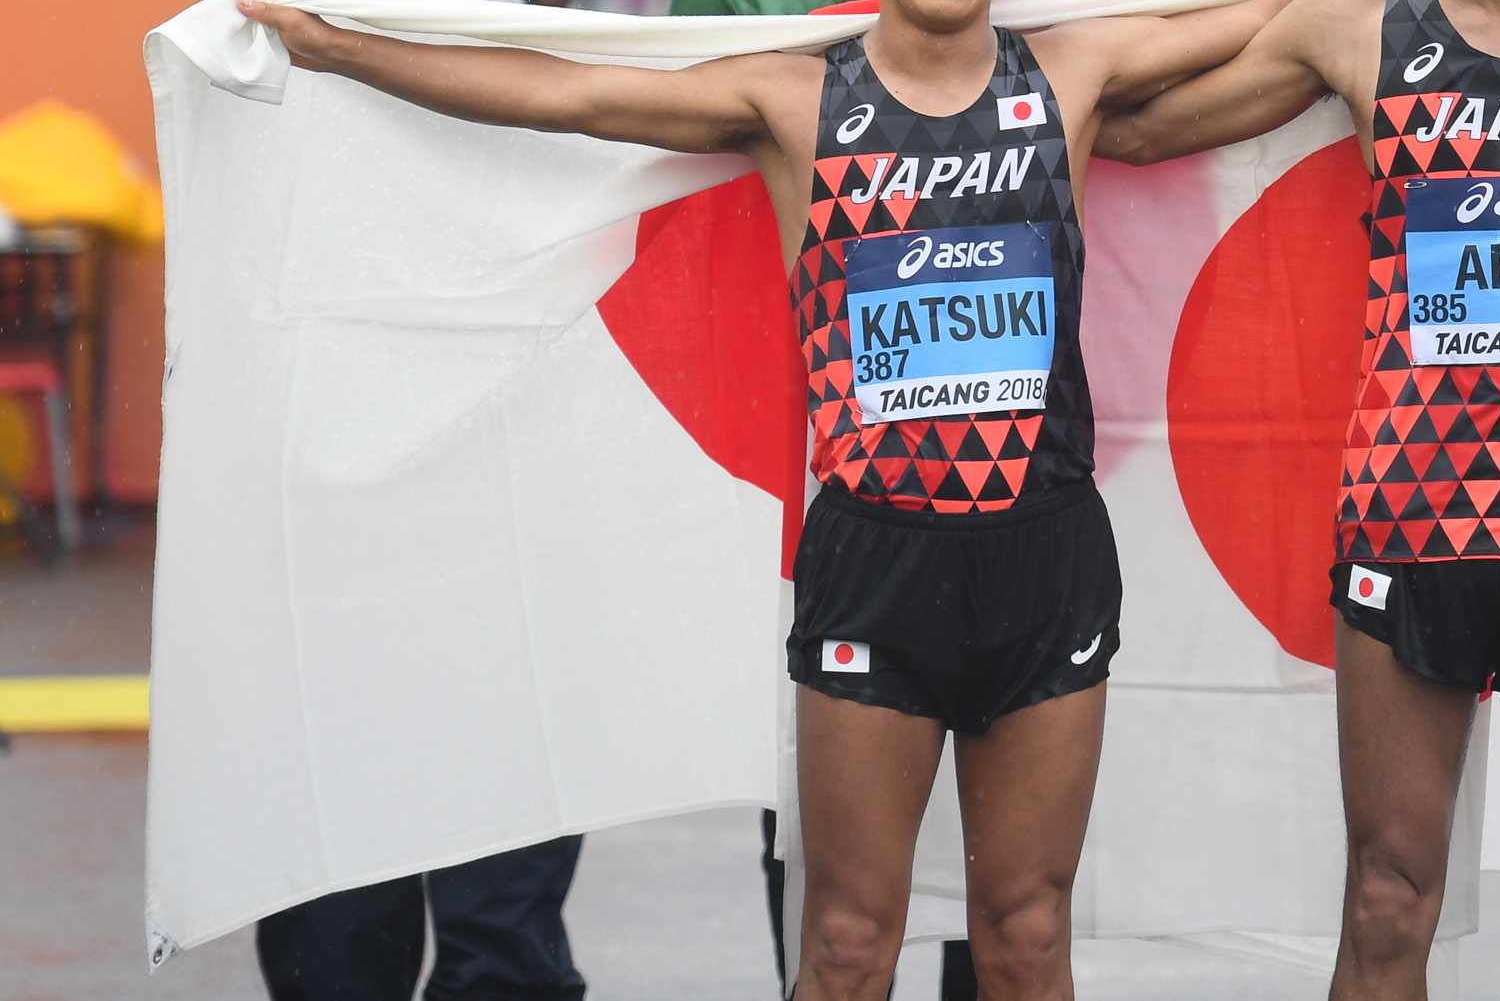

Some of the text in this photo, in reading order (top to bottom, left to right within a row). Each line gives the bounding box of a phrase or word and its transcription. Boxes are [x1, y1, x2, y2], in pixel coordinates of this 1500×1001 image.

[851, 145, 1037, 204] JAPAN
[933, 240, 1005, 268] asics
[861, 290, 1047, 351] KATSUKI
[1413, 294, 1467, 323] 385
[857, 349, 909, 383] 387
[880, 377, 1043, 413] TAICANG 2018
